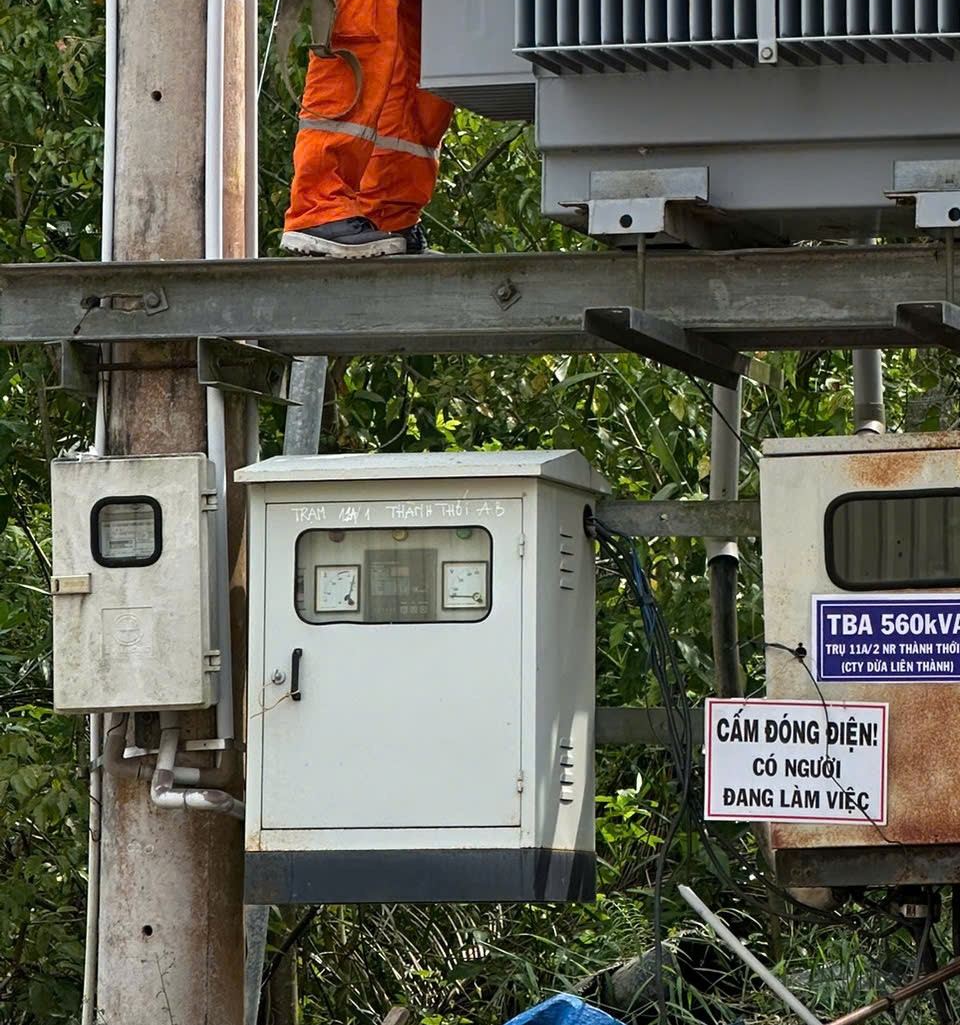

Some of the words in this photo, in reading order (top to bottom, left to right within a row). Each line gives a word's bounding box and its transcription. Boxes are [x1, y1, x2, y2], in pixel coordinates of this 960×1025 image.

[826, 613, 874, 636] TBA
[825, 643, 846, 657] TRỤ
[849, 643, 880, 655] 11A/2
[882, 643, 896, 655] NR
[899, 640, 933, 655] THÀNH
[935, 640, 960, 654] THỚI
[841, 661, 864, 674] (CTY
[867, 658, 888, 673] DỪA
[890, 658, 914, 673] LIÊN
[916, 658, 954, 673] THÀNH)
[716, 708, 759, 743] CẤM
[764, 713, 820, 745] ĐÓNG
[826, 716, 878, 753] ĐIỆN!
[752, 753, 778, 778] CÓ
[785, 753, 841, 779] NGƯỜI
[723, 787, 774, 809] ĐANG
[780, 785, 821, 810] LÀM
[826, 787, 870, 814] VIỆC
